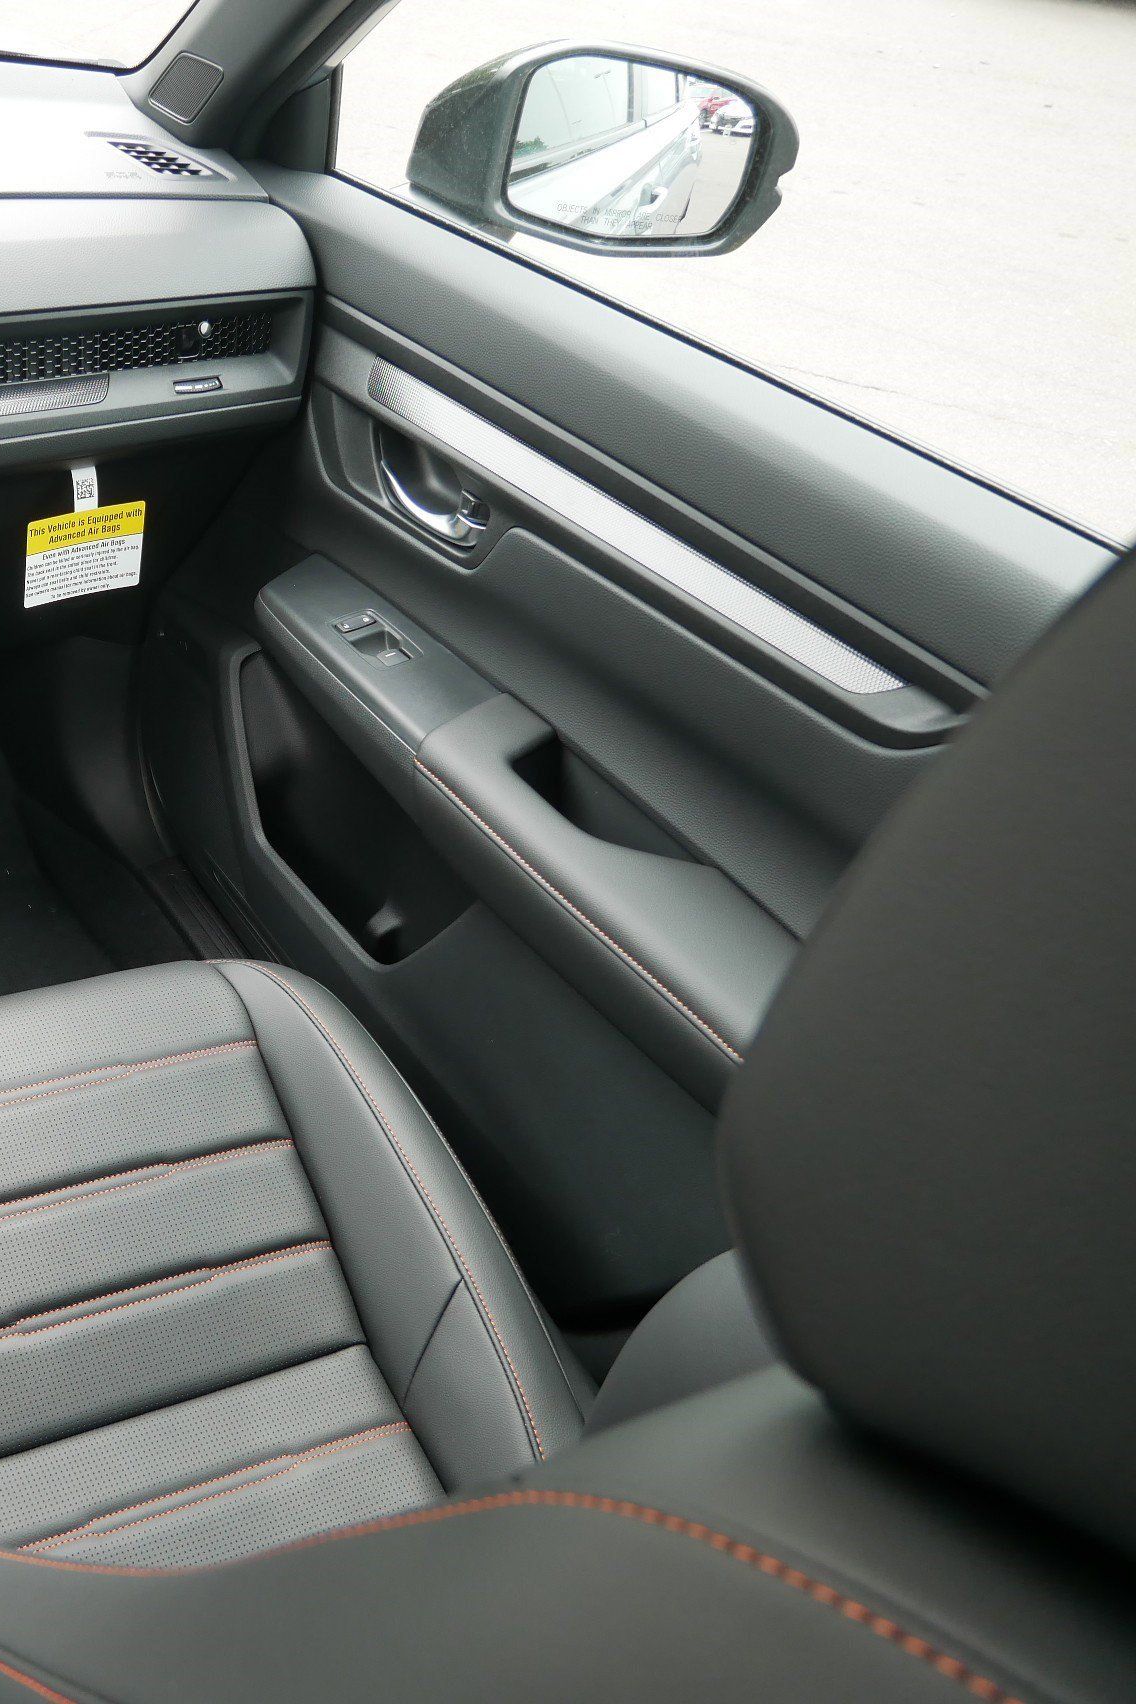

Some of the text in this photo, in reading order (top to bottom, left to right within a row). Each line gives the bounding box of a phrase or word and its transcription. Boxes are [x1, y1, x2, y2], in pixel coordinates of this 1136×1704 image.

[556, 203, 588, 215] OBJECTS
[30, 508, 143, 538] This Vehicle is Equipped with
[48, 523, 120, 544] Advanced Air Bags
[70, 544, 100, 554] Advanced
[100, 540, 110, 548] Air
